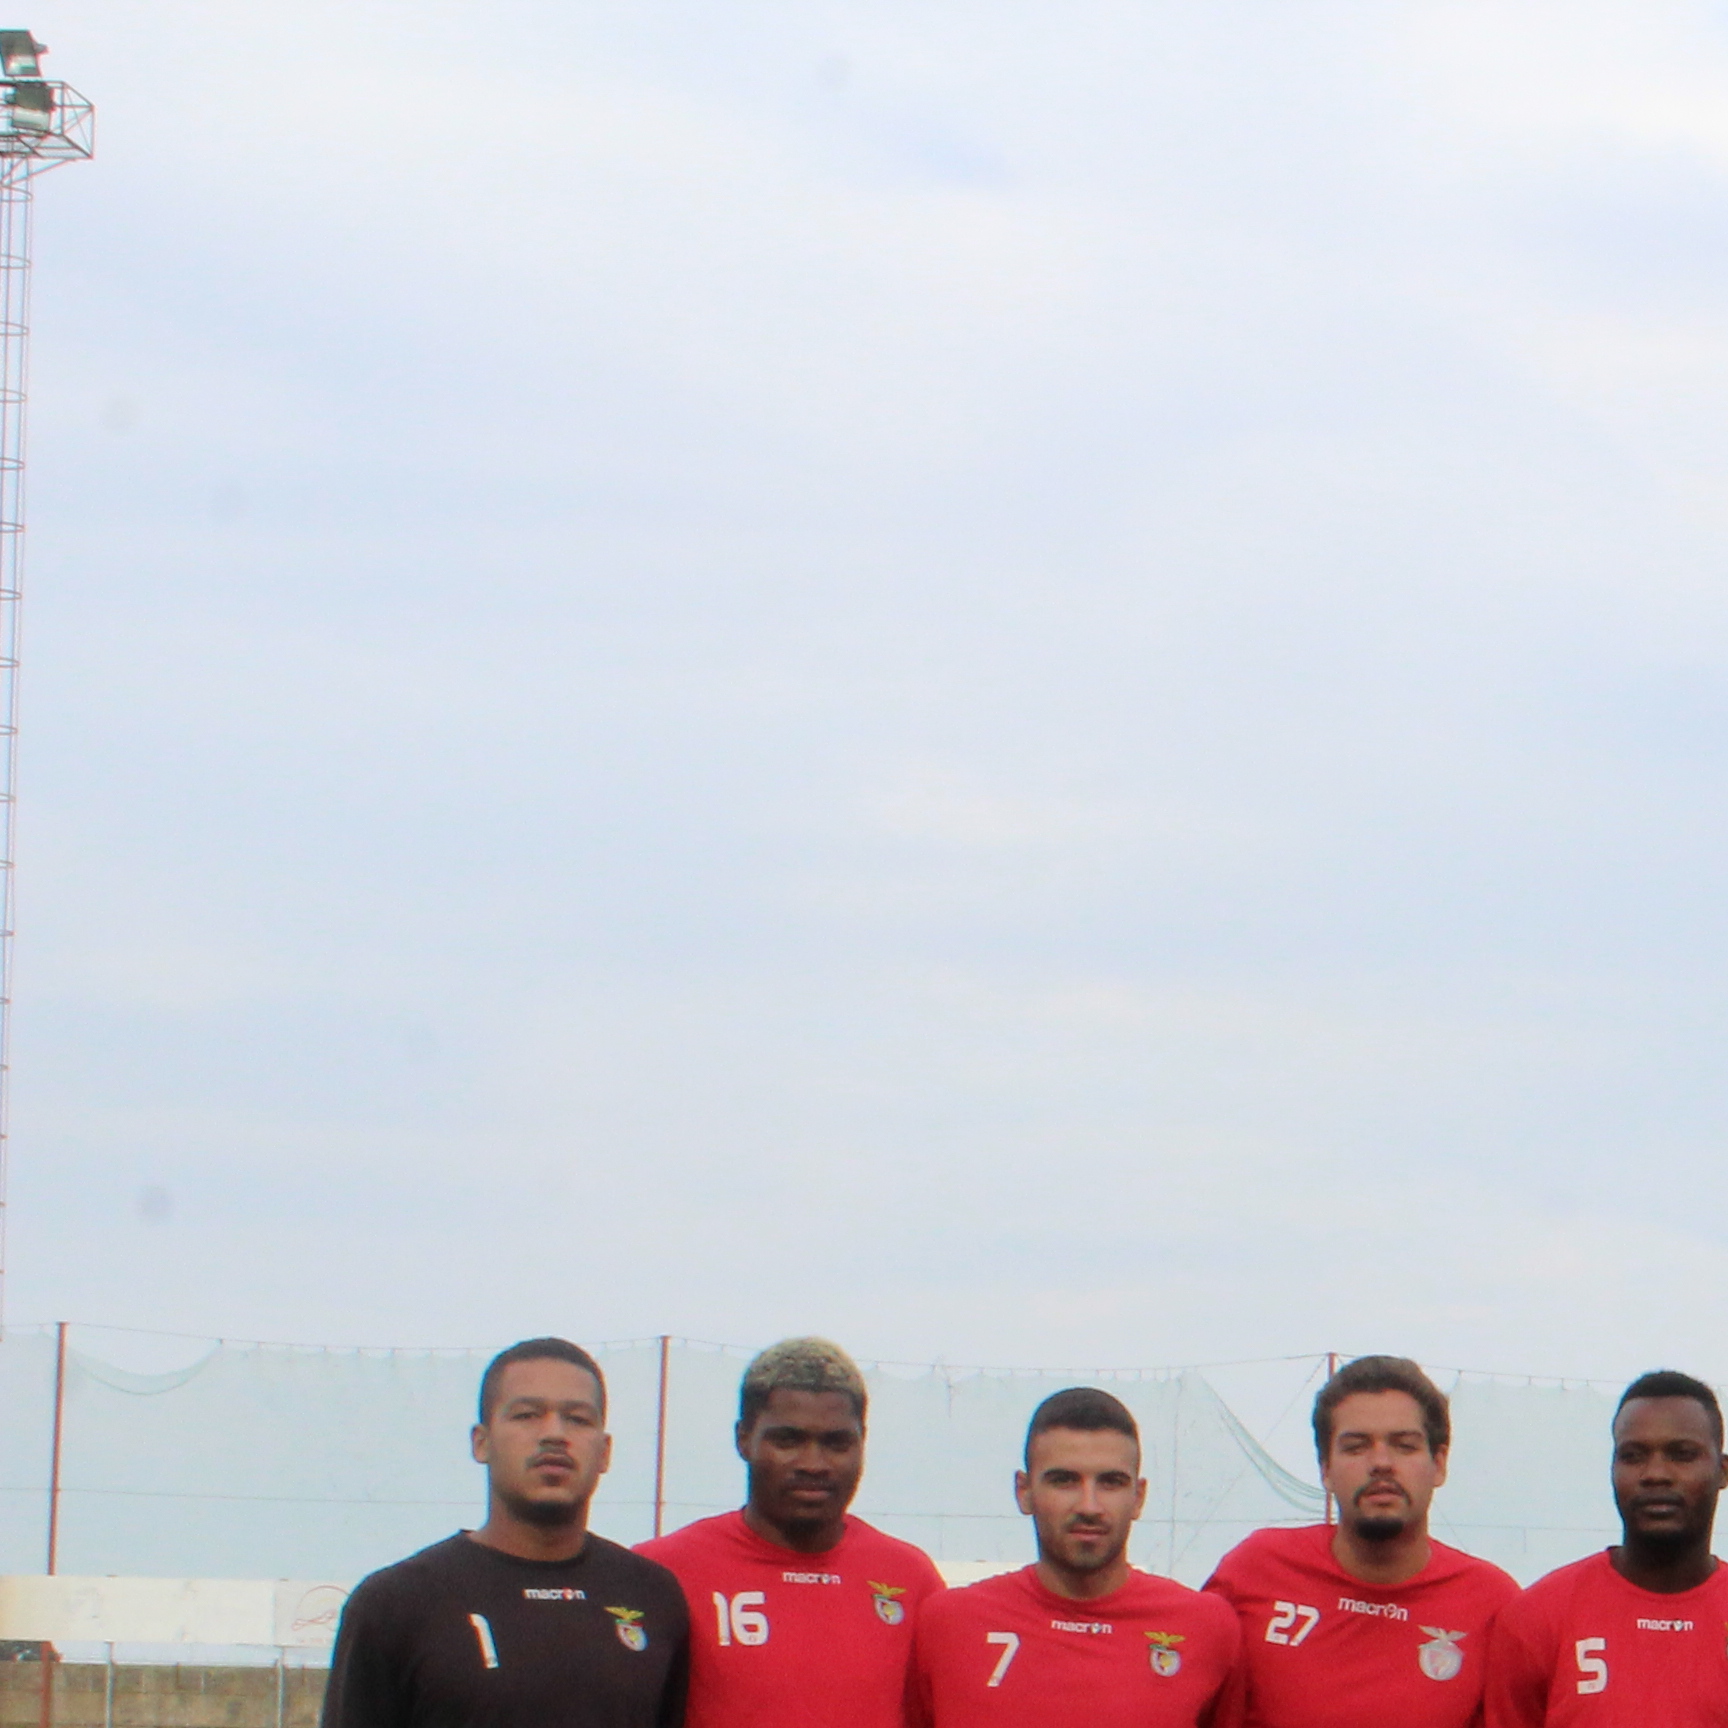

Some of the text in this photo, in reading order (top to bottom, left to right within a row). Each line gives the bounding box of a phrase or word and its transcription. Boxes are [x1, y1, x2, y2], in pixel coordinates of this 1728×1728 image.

[524, 1589, 585, 1600] macron
[782, 1572, 841, 1584] macron
[713, 1591, 768, 1646] 16
[1265, 1601, 1319, 1646] 27
[1337, 1598, 1408, 1621] macron
[1637, 1619, 1693, 1631] macron
[471, 1614, 498, 1668] 1
[1051, 1620, 1112, 1634] macron
[987, 1632, 1020, 1687] 7
[1576, 1637, 1607, 1694] 5
